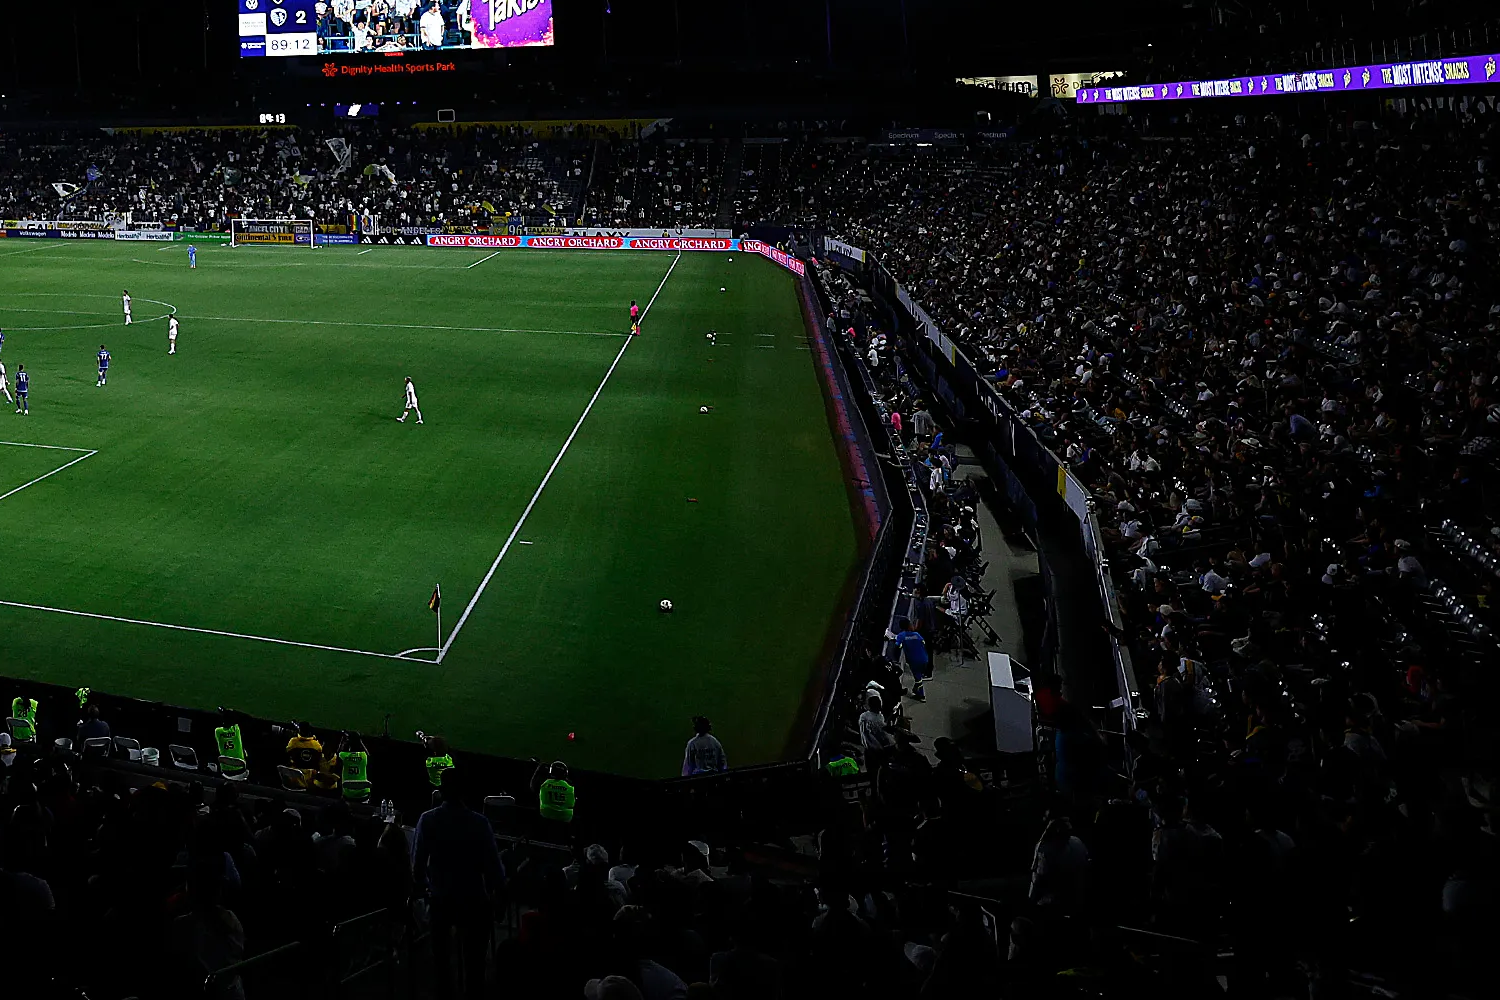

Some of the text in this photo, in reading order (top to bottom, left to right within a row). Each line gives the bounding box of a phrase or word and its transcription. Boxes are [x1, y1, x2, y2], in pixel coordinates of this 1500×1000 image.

[295, 10, 307, 24] 2
[271, 39, 310, 50] 89:12
[341, 62, 456, 75] Dignity Health Sports Park
[1381, 61, 1469, 85] THE MOST INTENSE SNACKS
[509, 225, 521, 235] 96
[434, 236, 516, 246] ANGRY ORCHARD
[532, 238, 618, 248] ANGRY ORCHARD
[635, 239, 726, 249] ANGRY ORCHARD
